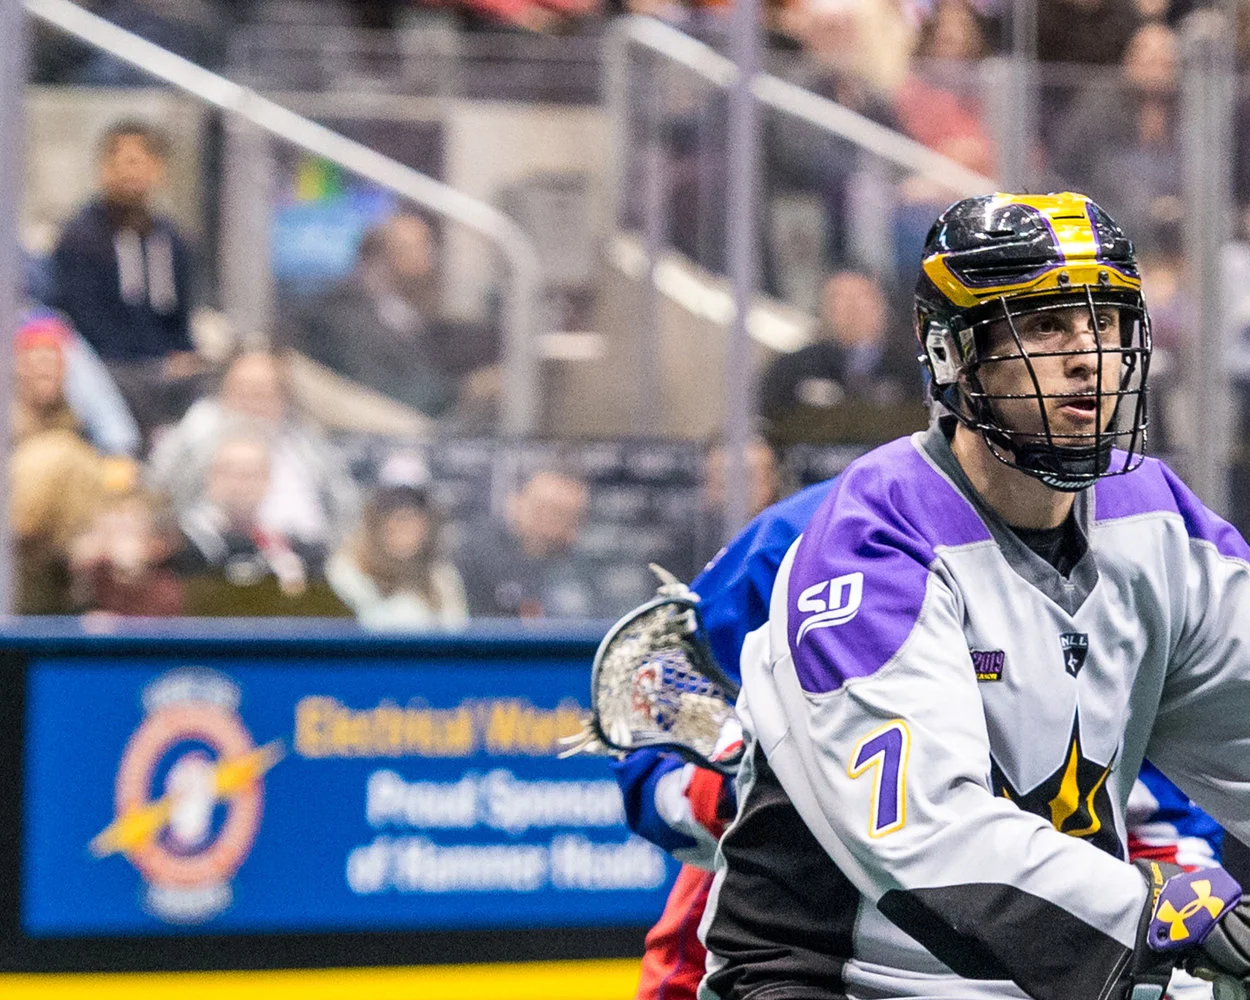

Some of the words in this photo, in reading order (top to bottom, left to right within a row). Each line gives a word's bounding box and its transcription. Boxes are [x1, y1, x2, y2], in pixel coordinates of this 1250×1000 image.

[972, 651, 1003, 672] 2019
[1060, 635, 1087, 646] NLL
[296, 697, 474, 757] Electrical
[486, 697, 600, 757] Work
[367, 770, 476, 829] Proud
[488, 769, 627, 836] Sponso
[848, 718, 911, 839] 7
[347, 835, 394, 893] of
